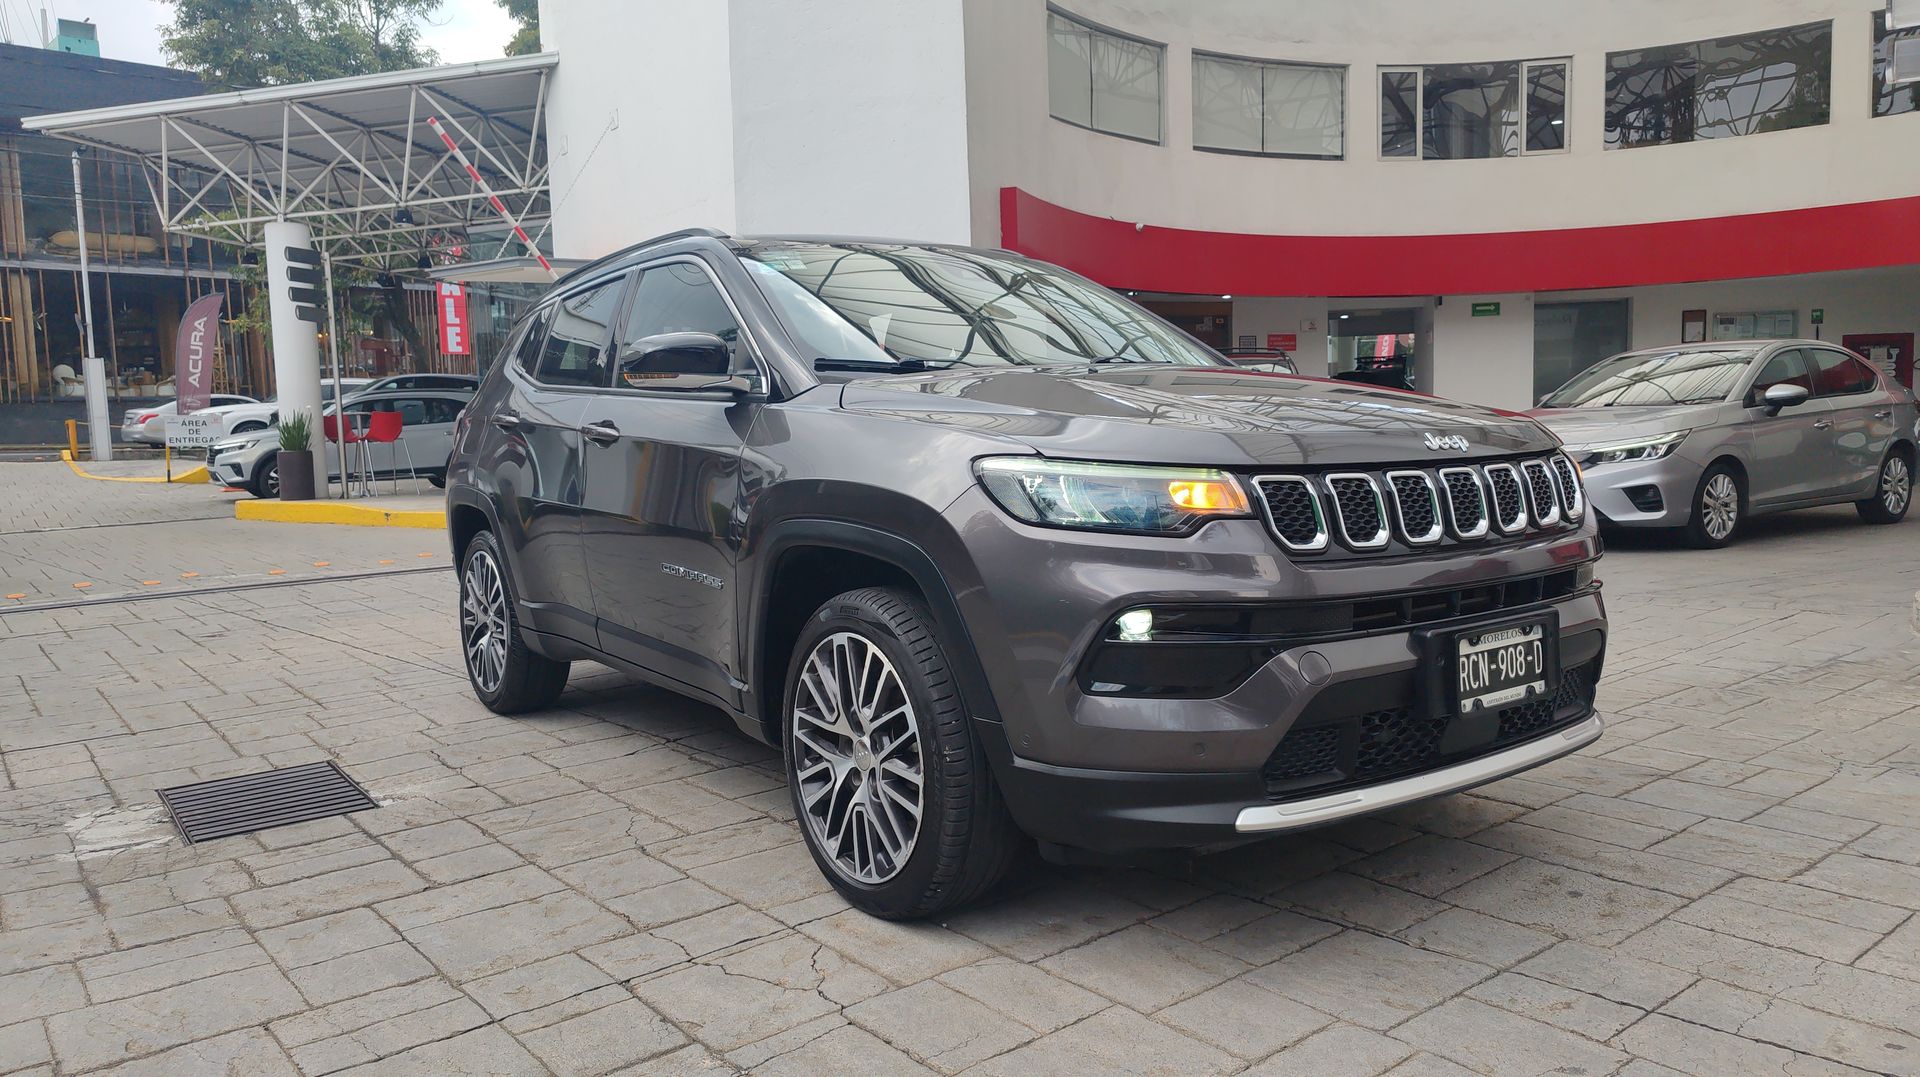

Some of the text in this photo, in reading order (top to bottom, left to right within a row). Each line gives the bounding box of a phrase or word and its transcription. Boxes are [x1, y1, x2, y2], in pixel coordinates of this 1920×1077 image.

[440, 245, 463, 353] ALE
[188, 316, 208, 389] ACURA
[181, 418, 208, 427] ÁREA
[188, 428, 201, 436] DE
[1424, 432, 1470, 453] Jeep
[1459, 640, 1543, 693] RCN-908-D
